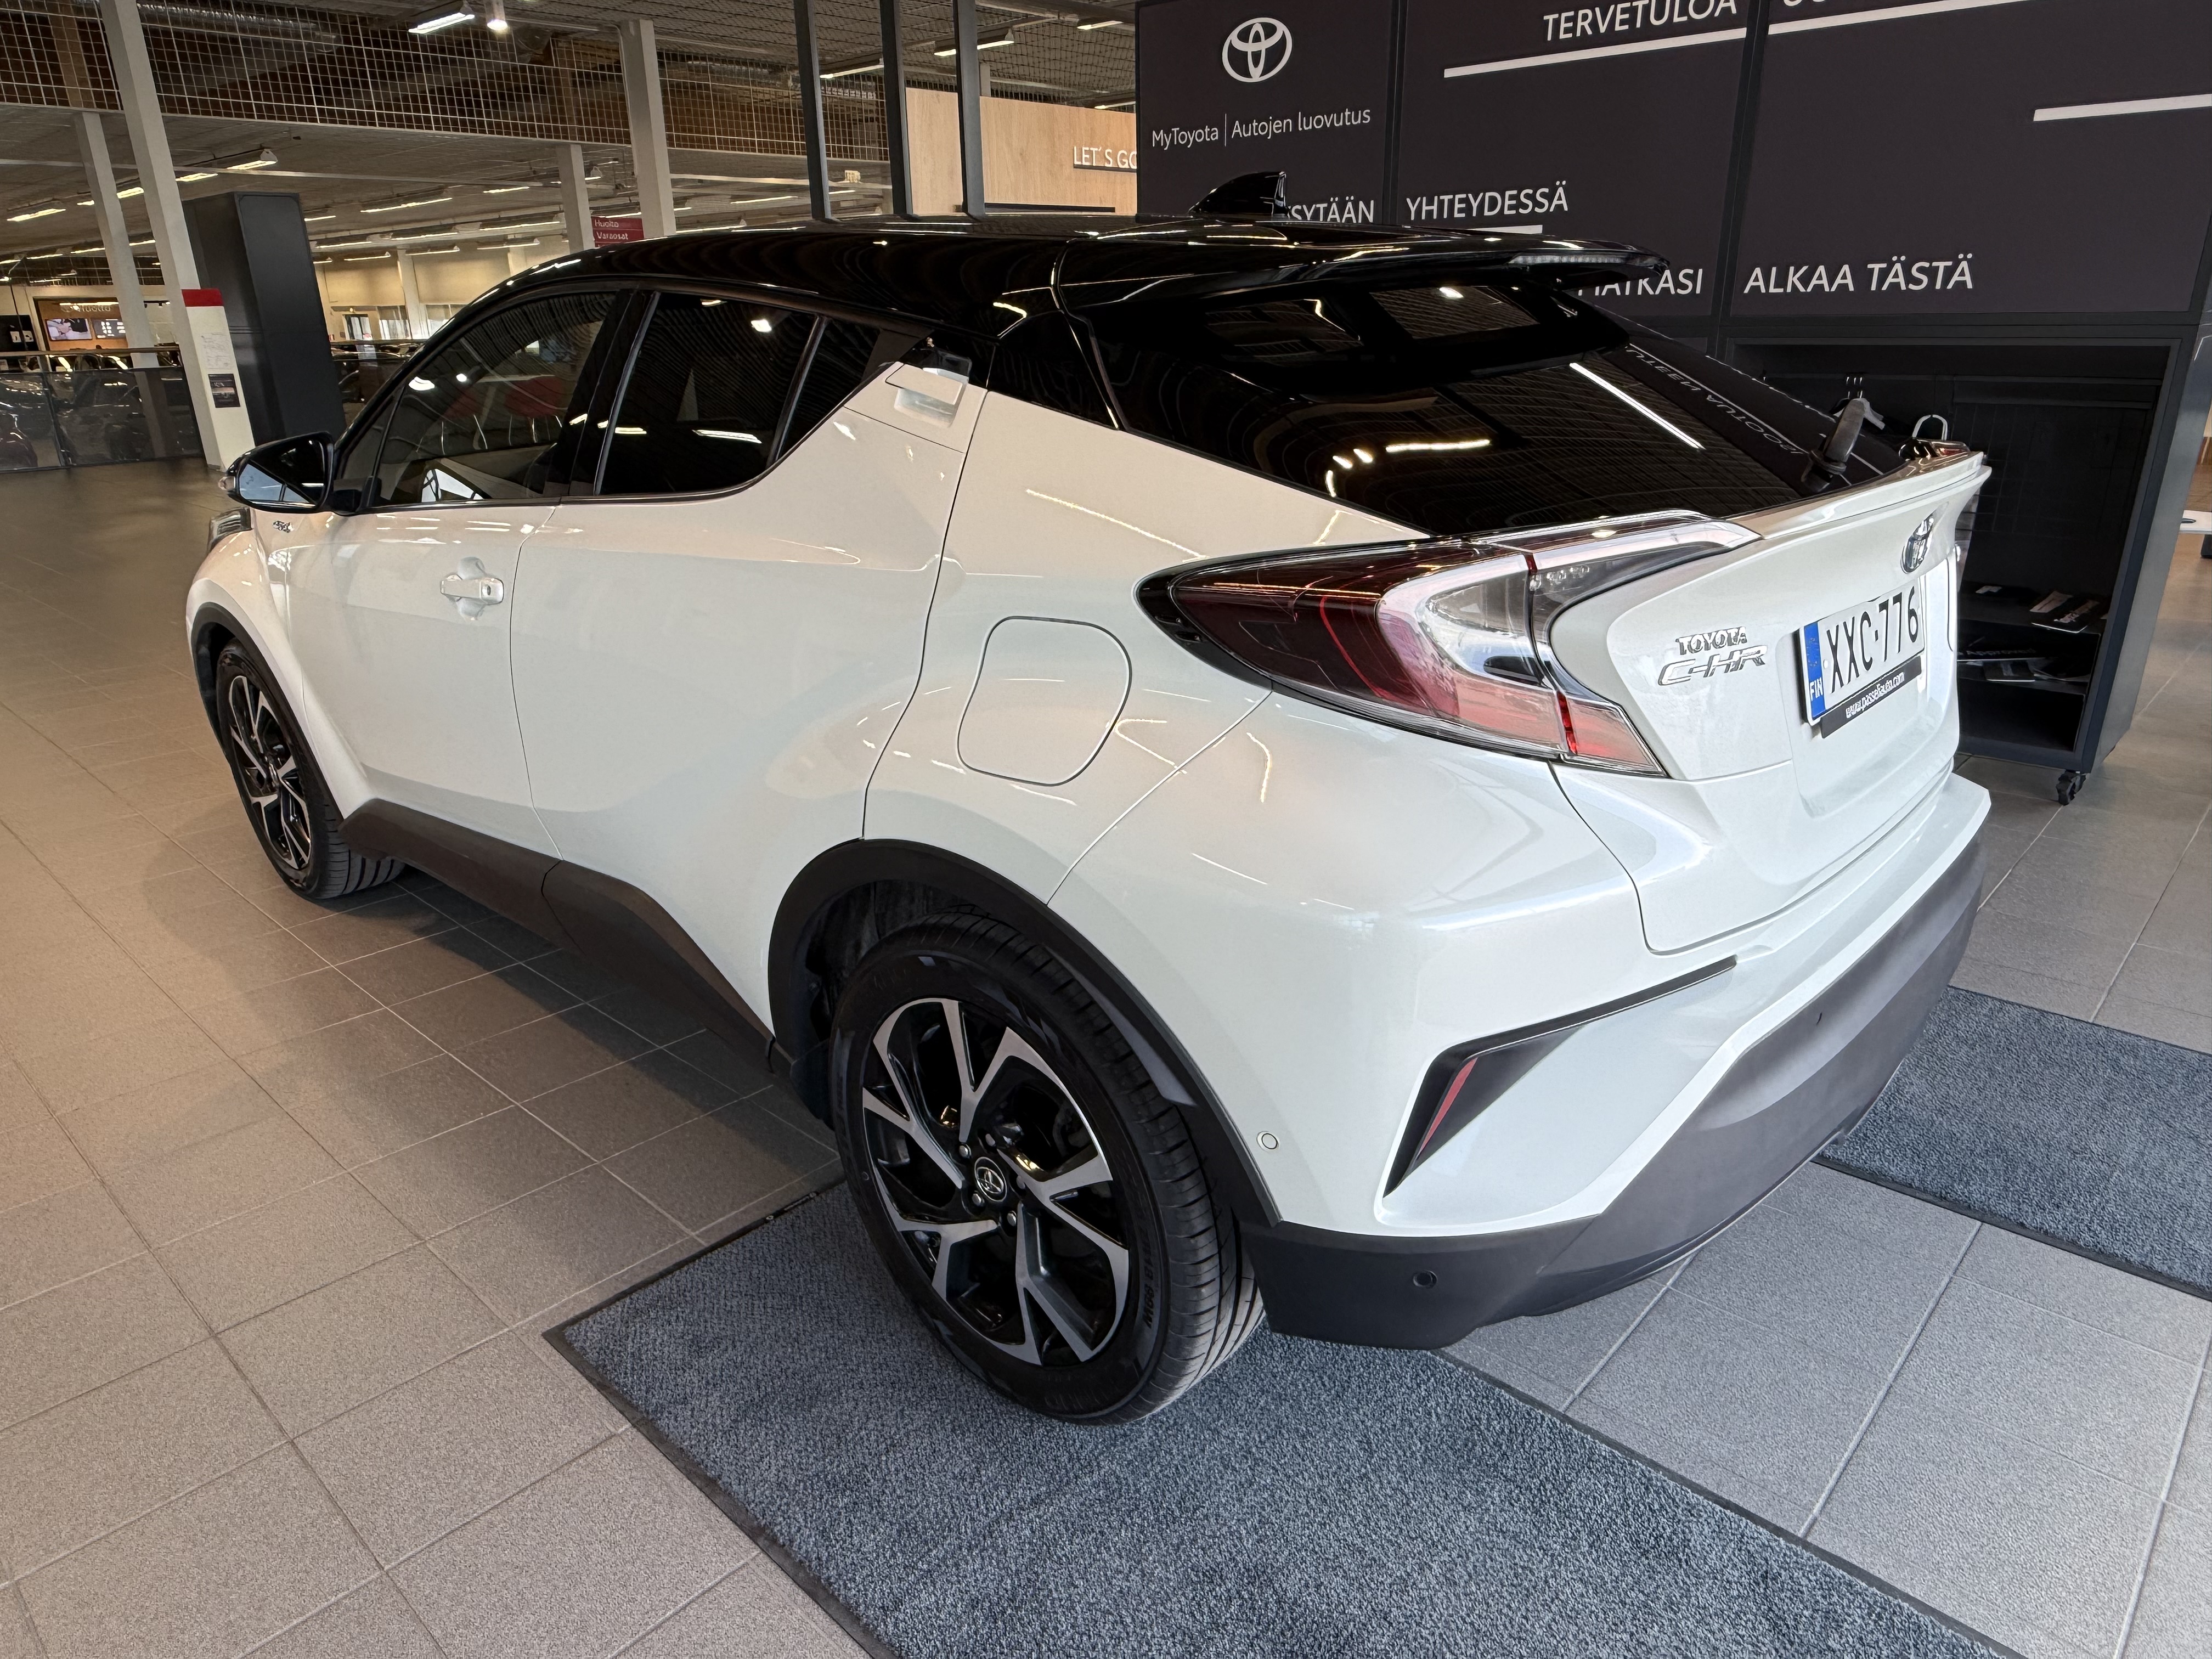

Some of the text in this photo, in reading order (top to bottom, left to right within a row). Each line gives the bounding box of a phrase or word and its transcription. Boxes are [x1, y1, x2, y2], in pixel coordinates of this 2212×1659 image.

[1543, 0, 1737, 41] TERVETULOA
[1152, 108, 1370, 150] MyToyota Autojen luovutus
[1288, 180, 1568, 223] SYTÄÄN YHTEYDESSÄ
[1578, 253, 1973, 296] KASI ALKAA TÄSTÄ
[1675, 627, 1747, 655] TOYOTA
[1826, 585, 1919, 694] XXC-776
[1658, 645, 1768, 686] C-HR
[1809, 677, 1824, 702] FIN
